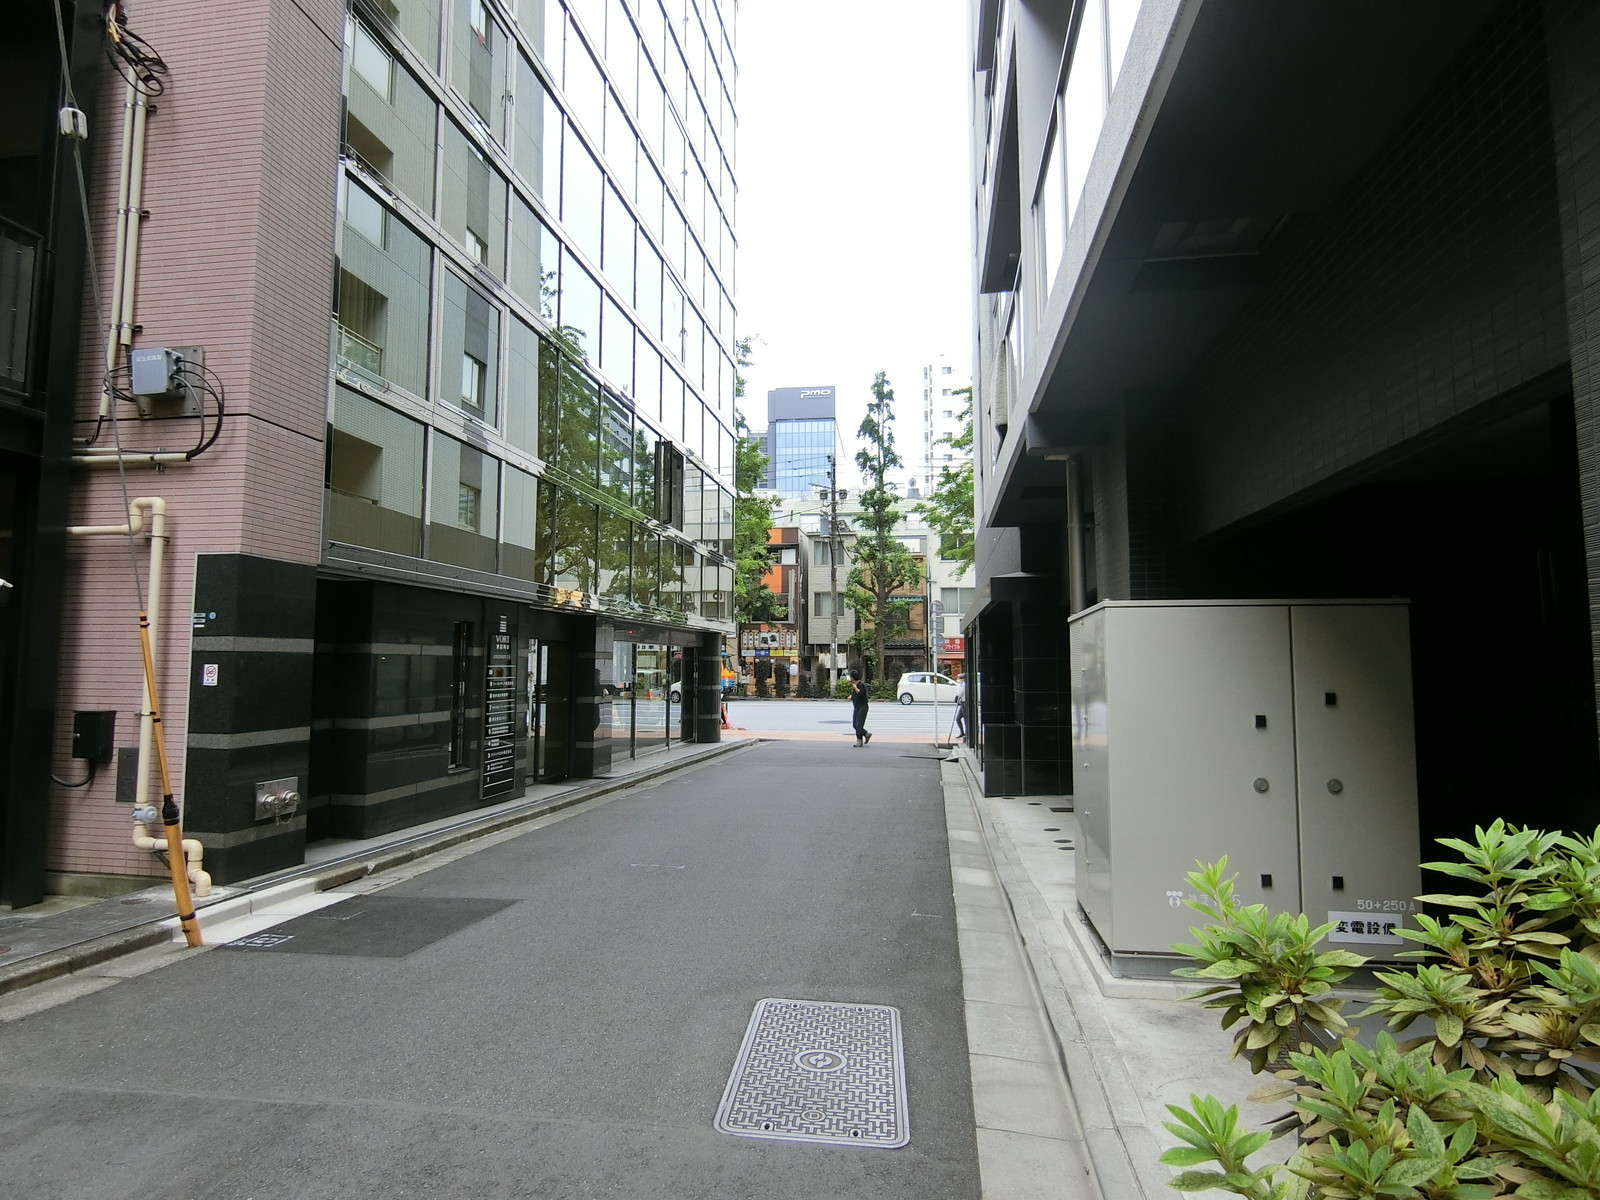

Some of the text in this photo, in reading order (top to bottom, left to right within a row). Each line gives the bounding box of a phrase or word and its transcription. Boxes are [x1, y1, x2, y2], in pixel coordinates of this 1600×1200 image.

[495, 634, 510, 643] VORT
[1335, 920, 1398, 936] 変電設備
